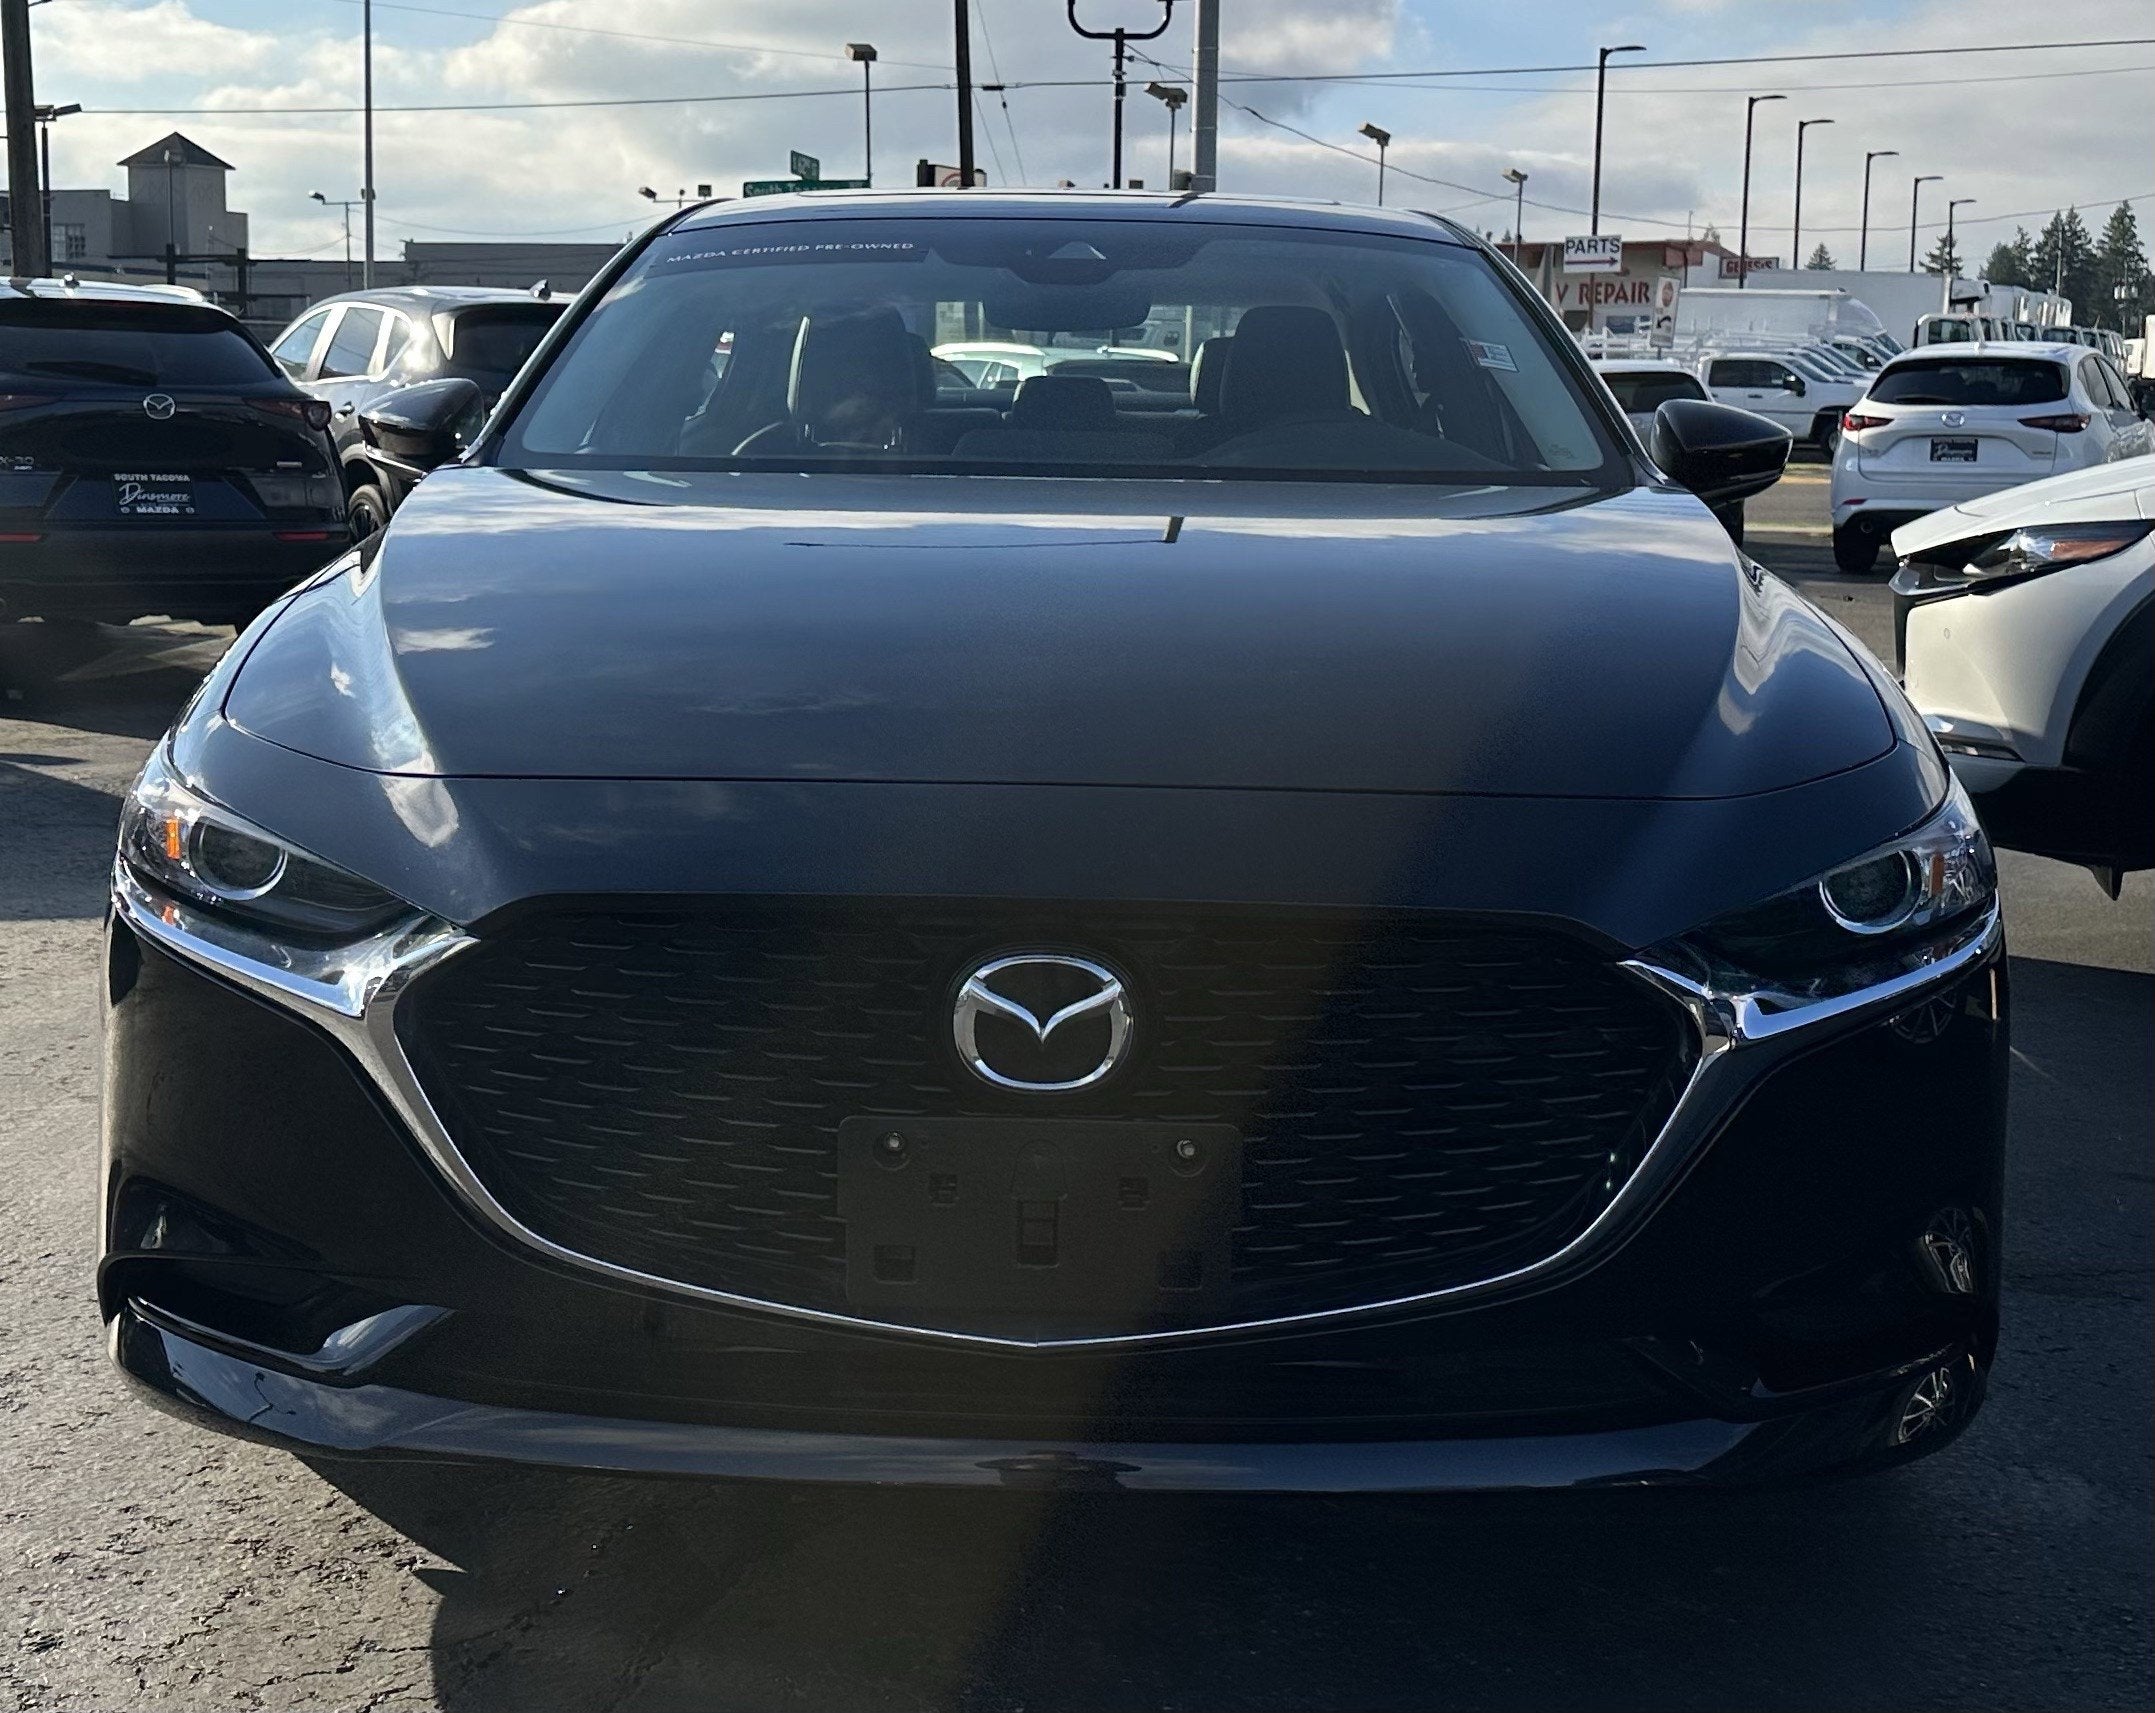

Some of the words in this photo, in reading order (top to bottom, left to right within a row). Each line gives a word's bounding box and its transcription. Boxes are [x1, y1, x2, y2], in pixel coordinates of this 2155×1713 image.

[667, 251, 726, 263] MAZDA
[731, 245, 810, 256] CERTIFIED
[815, 243, 914, 251] PRE-OWNED
[1565, 238, 1620, 254] PARTS
[1578, 280, 1651, 305] REPAIR
[114, 473, 149, 481] SOUTH
[136, 506, 180, 514] MAZDA
